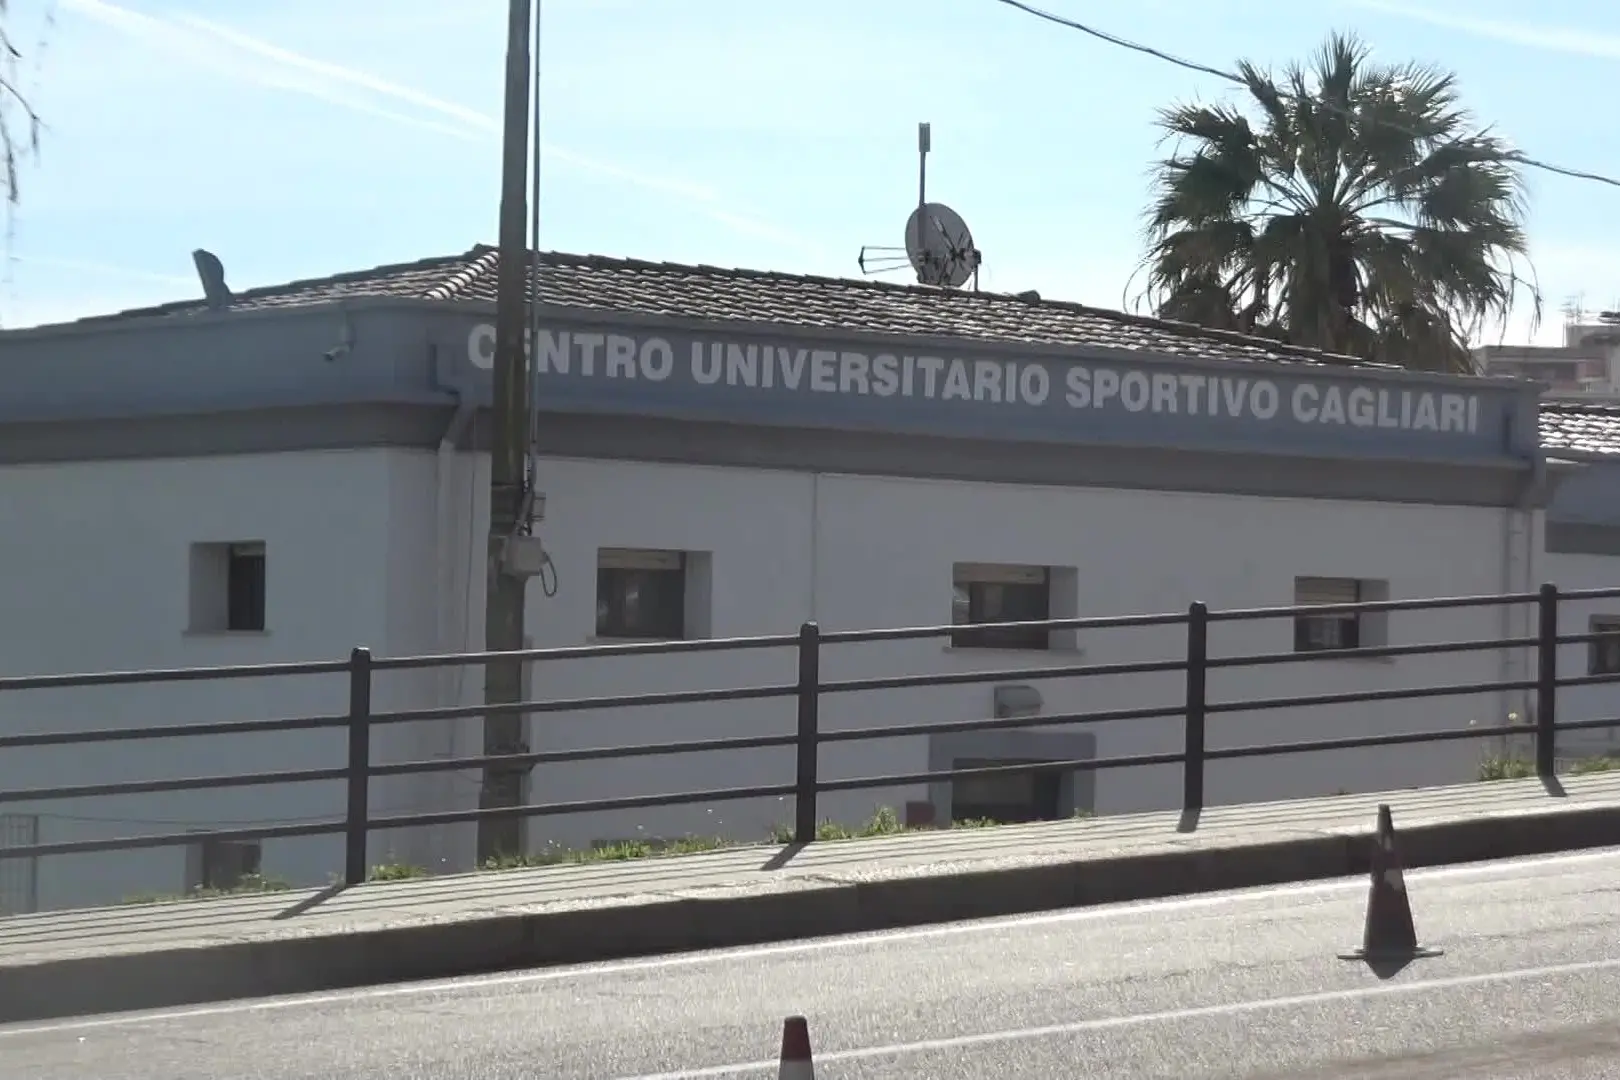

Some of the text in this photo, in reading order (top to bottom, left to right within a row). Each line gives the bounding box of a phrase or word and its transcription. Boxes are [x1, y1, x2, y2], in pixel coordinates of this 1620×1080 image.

[468, 324, 1478, 434] CNTRO UNIVERSITARIO SPORTIVO CAGLIARI
